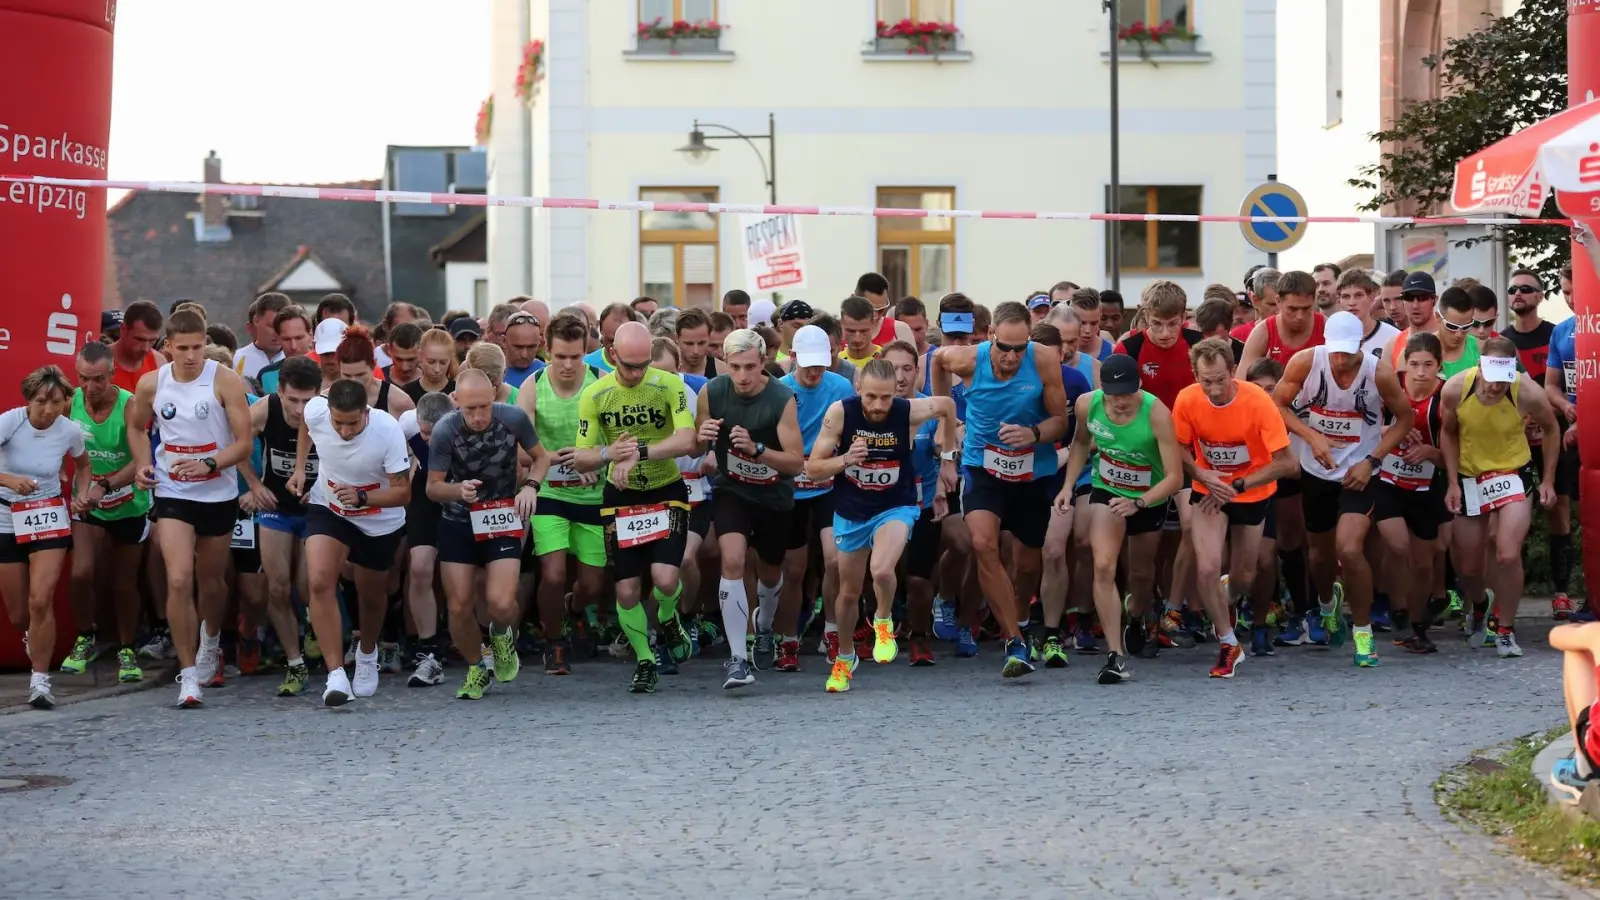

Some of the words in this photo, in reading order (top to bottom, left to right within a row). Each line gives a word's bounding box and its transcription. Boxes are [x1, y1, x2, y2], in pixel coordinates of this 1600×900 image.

[0, 124, 106, 170] Sparkasse
[0, 182, 86, 219] eipzig
[622, 404, 647, 415] Fair
[600, 407, 667, 430] Flock
[1318, 419, 1351, 431] 4374
[852, 434, 874, 445] GTE
[1206, 451, 1238, 461] 4317
[281, 460, 314, 472] 58
[736, 462, 769, 475] 4323
[993, 457, 1025, 471] 4367
[1392, 461, 1423, 474] 4448
[851, 468, 892, 485] 110
[1107, 468, 1141, 482] 4181
[1482, 480, 1511, 497] 4430
[24, 511, 58, 527] 4179
[482, 512, 515, 526] 4190
[627, 516, 659, 532] 4234
